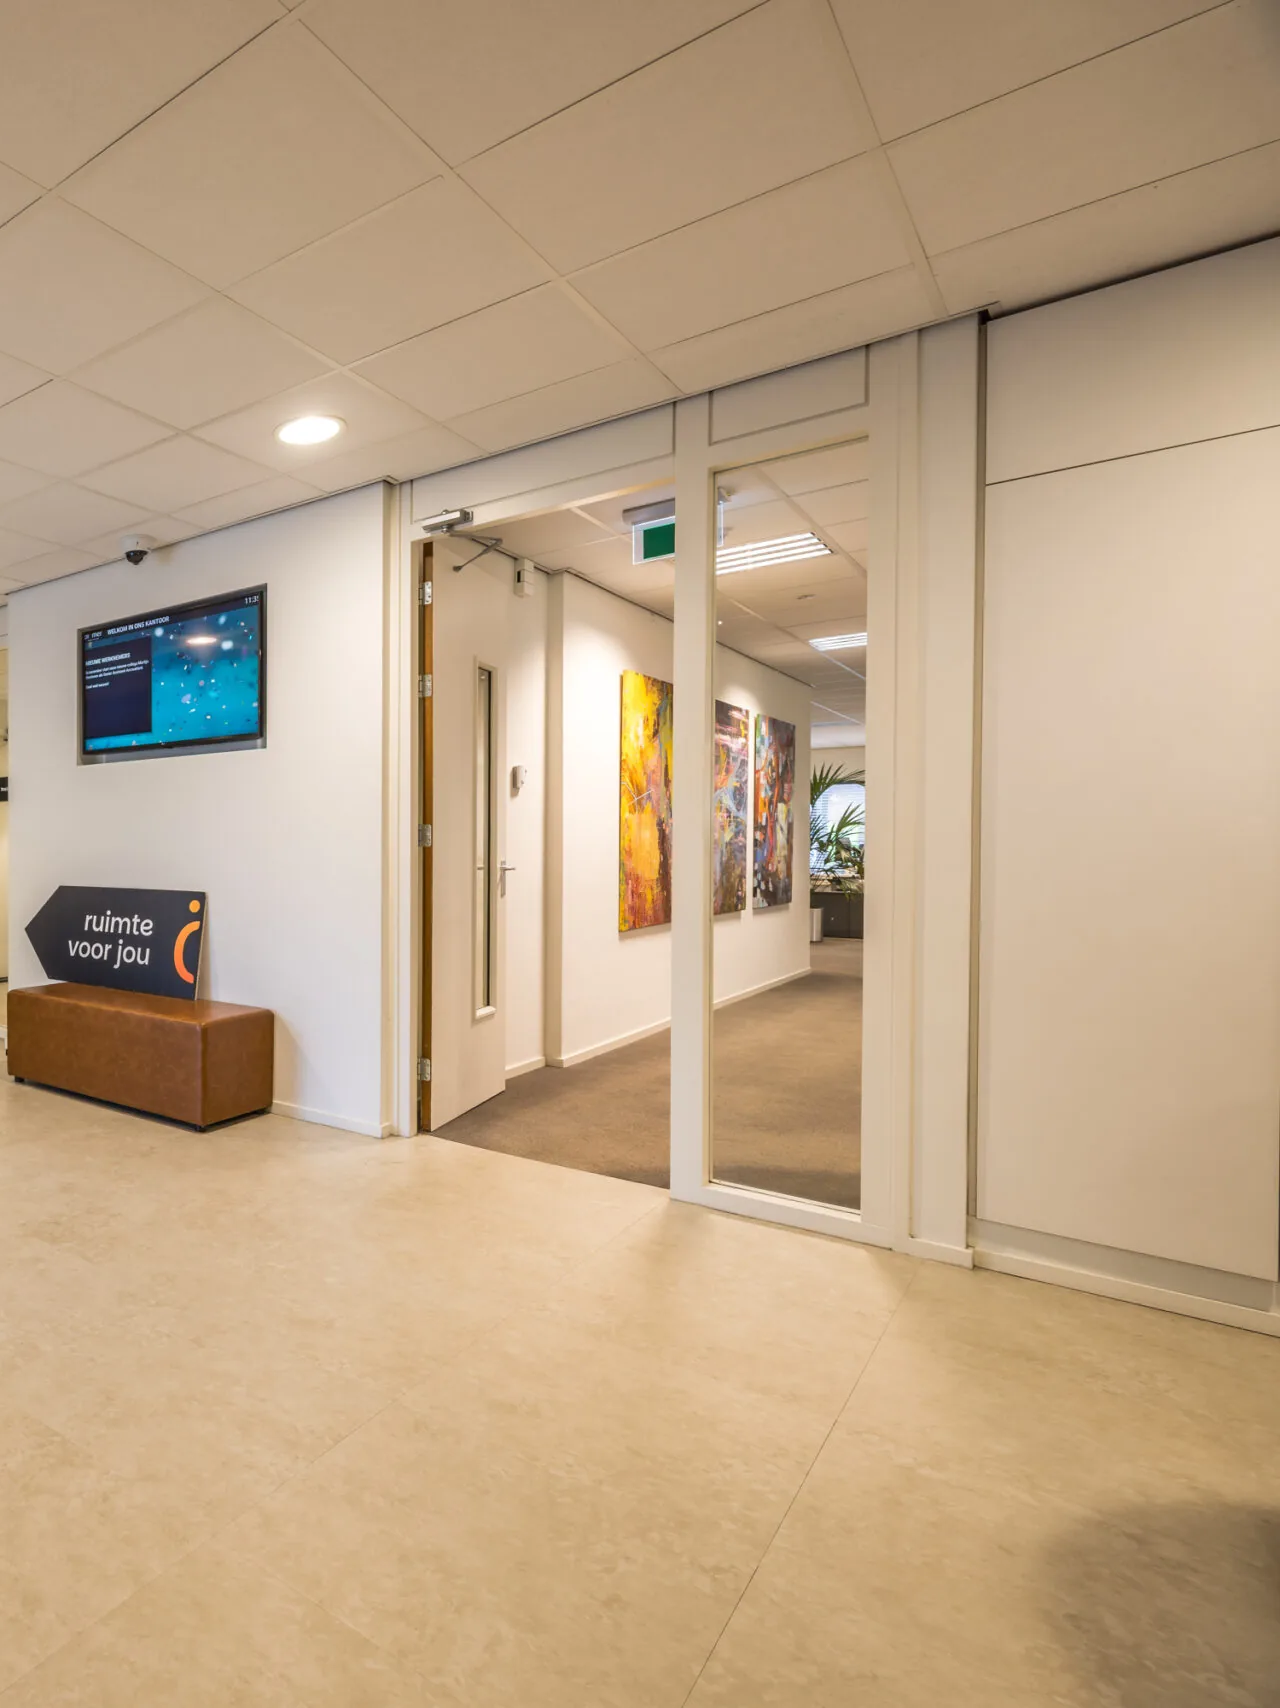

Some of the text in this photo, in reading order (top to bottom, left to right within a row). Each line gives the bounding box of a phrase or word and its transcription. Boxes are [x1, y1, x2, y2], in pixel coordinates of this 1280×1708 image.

[107, 625, 127, 636] WELKOM
[128, 623, 134, 631] IN
[134, 621, 144, 629] ONS
[145, 616, 170, 627] KANTOOR
[84, 910, 153, 936] ruimte
[68, 939, 151, 969] voor jou
